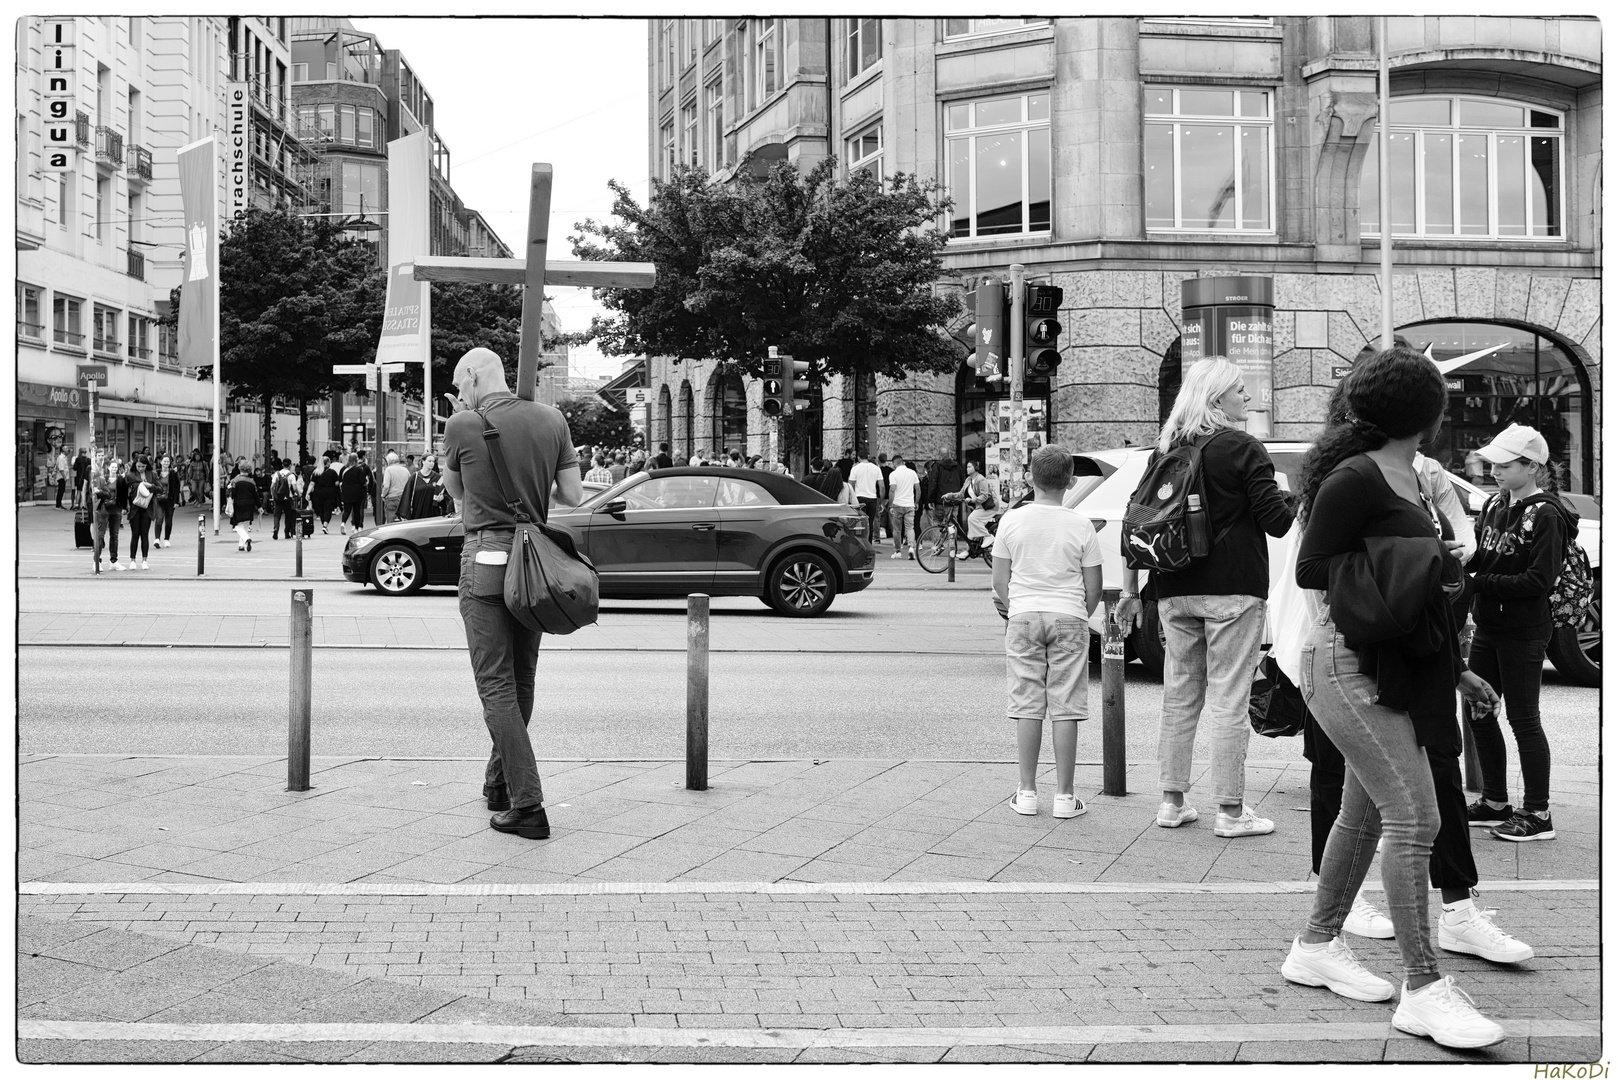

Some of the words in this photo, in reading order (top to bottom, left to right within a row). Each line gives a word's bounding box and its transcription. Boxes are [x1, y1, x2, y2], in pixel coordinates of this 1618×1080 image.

[232, 90, 245, 220] prachschule
[1230, 321, 1246, 331] Die
[1231, 333, 1246, 343] für
[1248, 333, 1265, 344] Dich
[1229, 347, 1241, 355] die
[80, 372, 106, 380] Apollo
[1445, 380, 1461, 389] wall
[51, 388, 68, 404] Apollo
